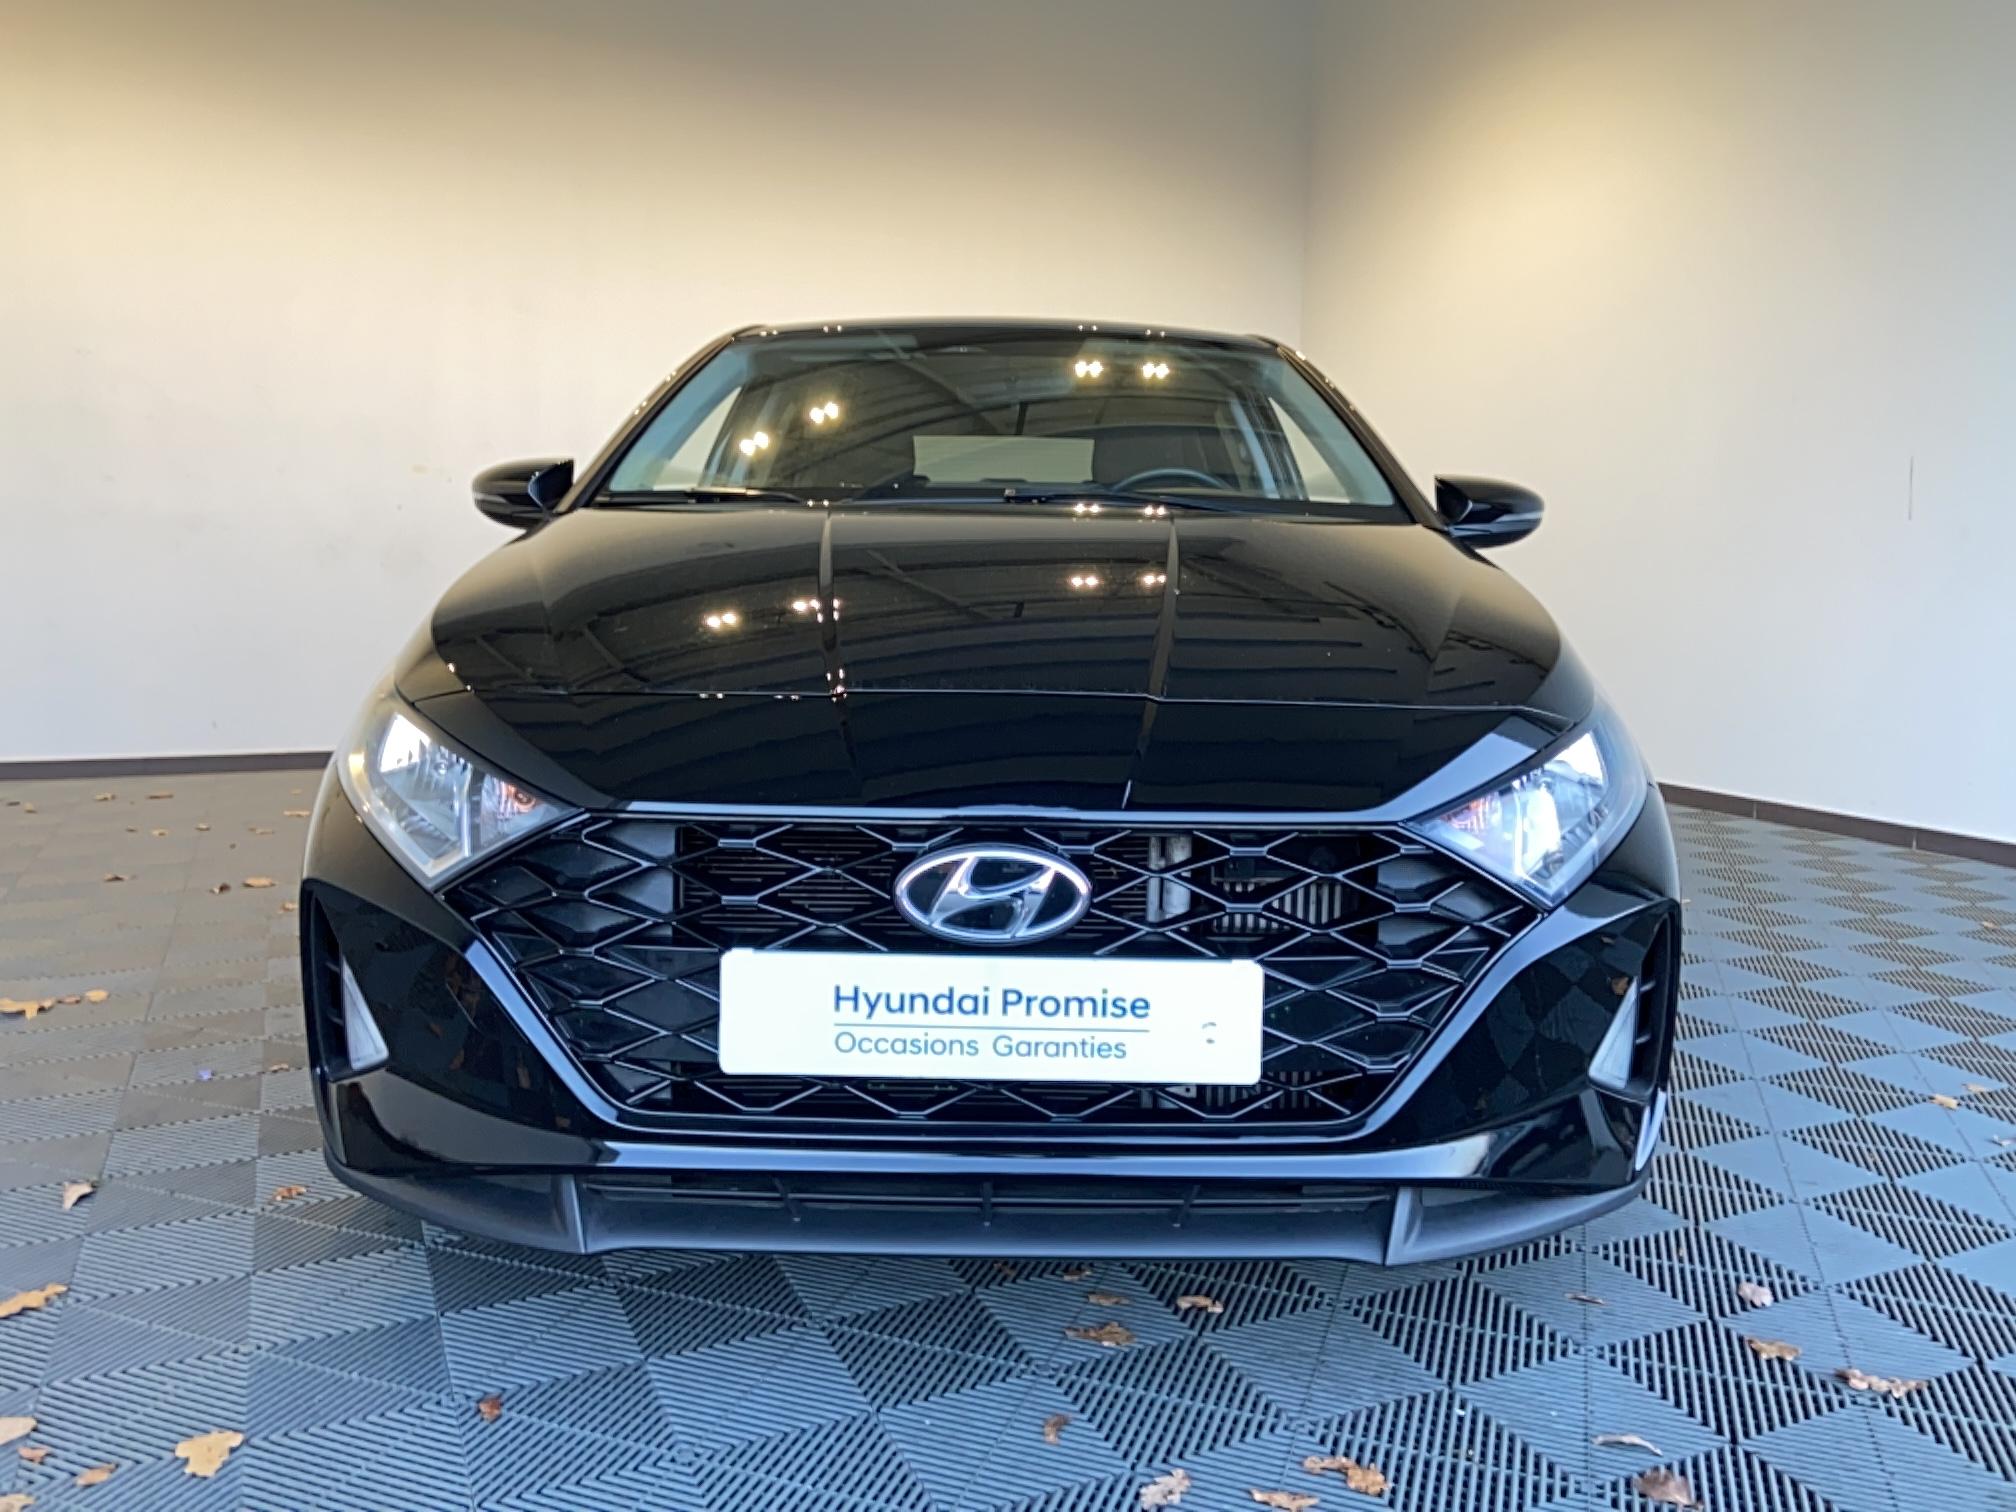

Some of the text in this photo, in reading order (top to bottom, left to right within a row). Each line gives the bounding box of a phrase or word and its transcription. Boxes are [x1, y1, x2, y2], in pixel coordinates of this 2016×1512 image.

[833, 985, 1151, 1019] Hyundai Promise
[834, 1032, 1128, 1059] Occasions Garanties
